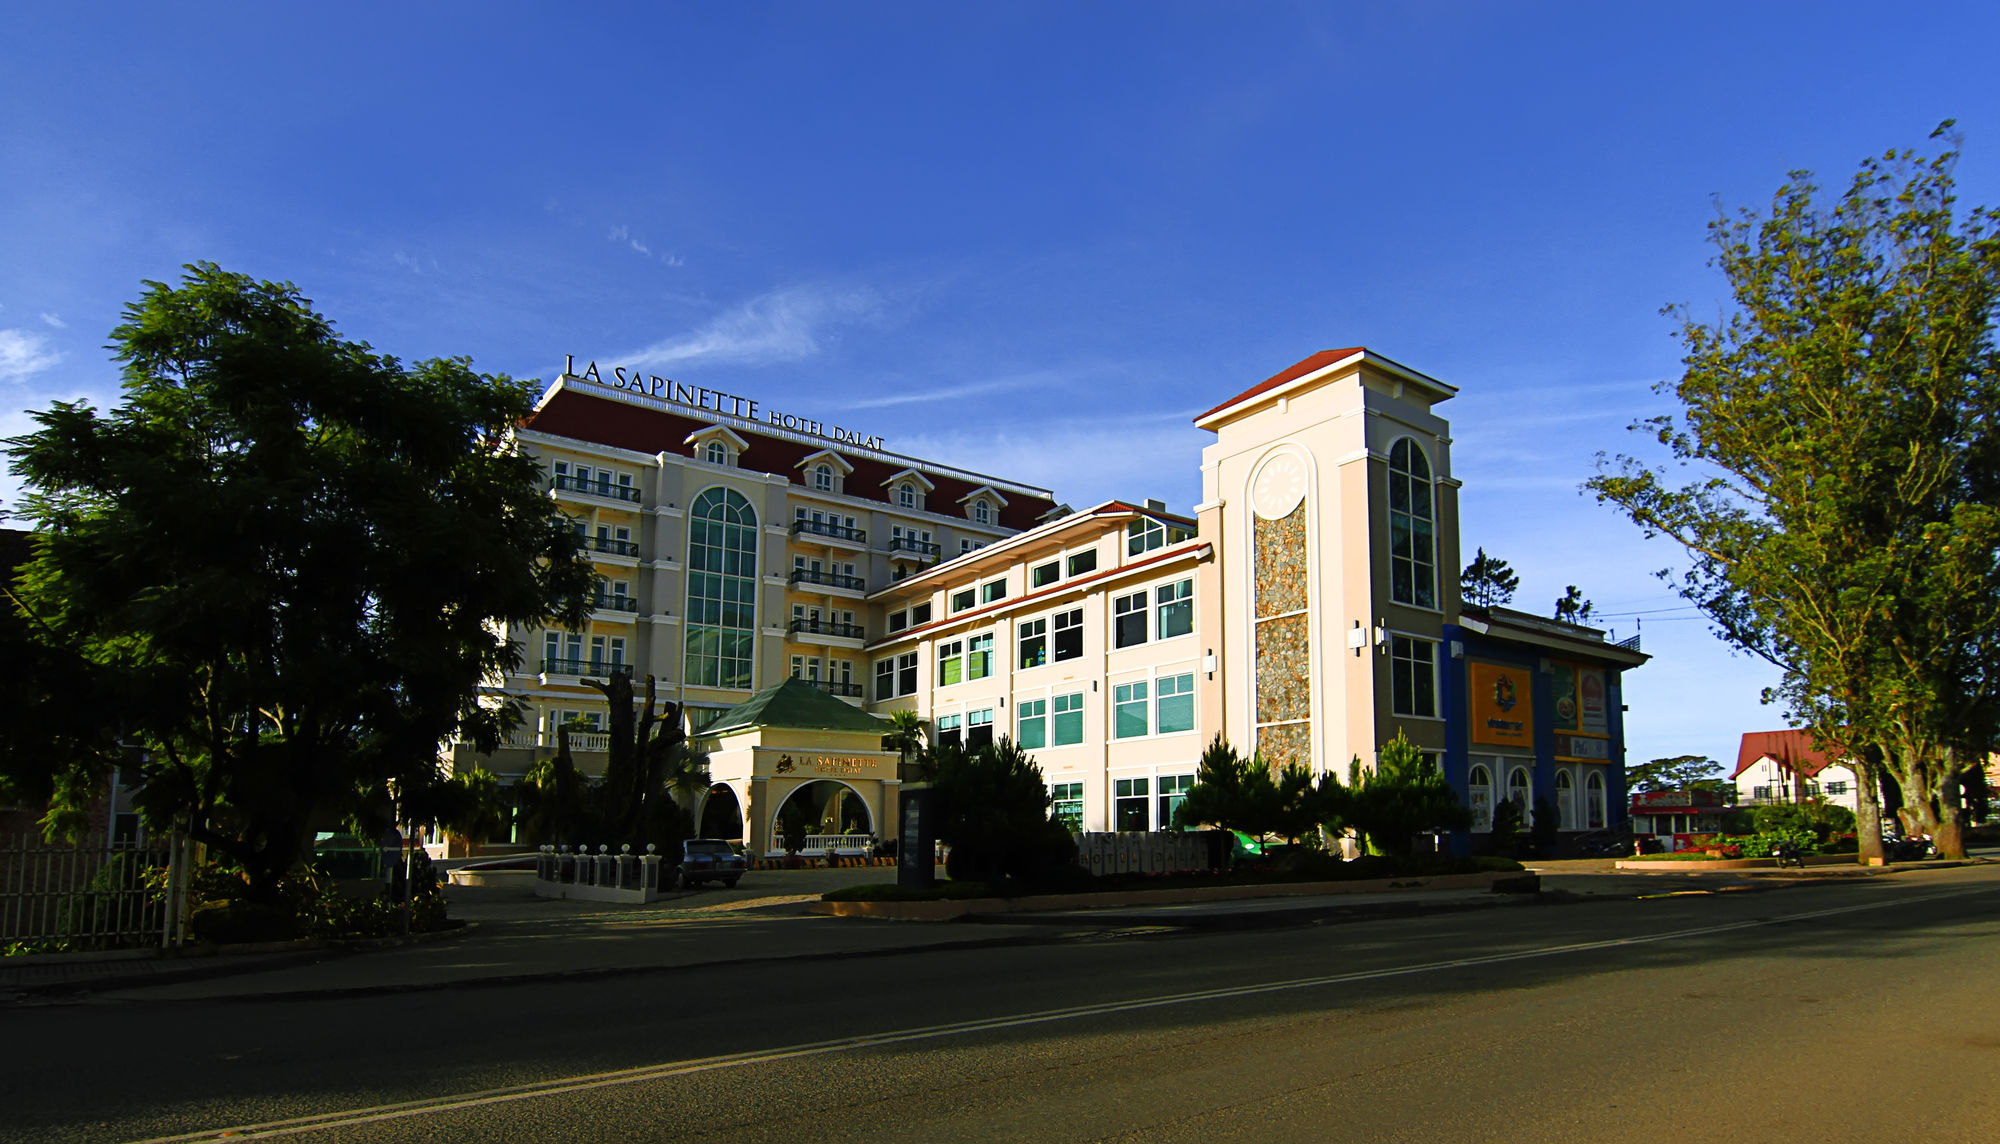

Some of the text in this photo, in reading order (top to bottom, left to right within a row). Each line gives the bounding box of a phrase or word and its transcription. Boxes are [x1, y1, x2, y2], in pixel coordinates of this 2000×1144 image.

[565, 354, 885, 451] LA SAPINETTE HOTEL DALAT
[799, 756, 812, 766] LA
